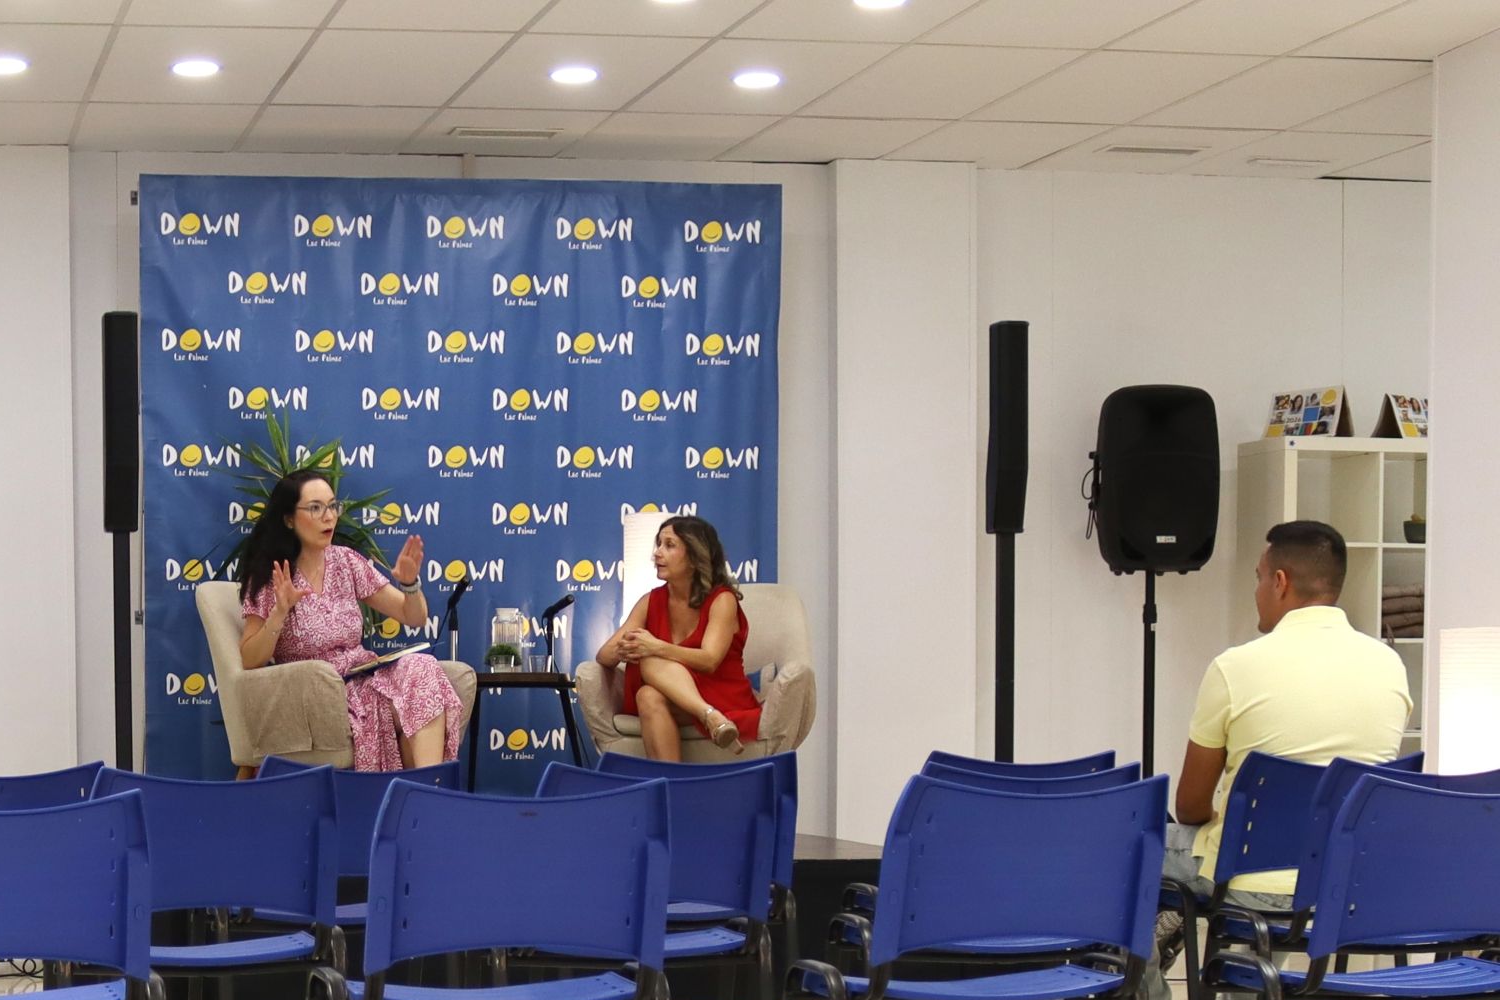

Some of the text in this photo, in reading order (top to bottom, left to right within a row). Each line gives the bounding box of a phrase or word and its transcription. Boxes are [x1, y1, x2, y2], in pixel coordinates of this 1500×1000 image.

[161, 212, 240, 238] DOWN
[294, 214, 373, 239] DOWN
[427, 215, 504, 240] DOWN
[557, 217, 633, 242] DOWN
[684, 219, 761, 244] DOWN
[173, 236, 208, 246] Las Palmas
[306, 238, 341, 248] Las Palmas
[439, 239, 473, 249] Las Palmas
[568, 241, 603, 250] Las Palmas
[696, 243, 730, 253] Las Palmas
[228, 271, 307, 296] DOWN
[361, 271, 440, 296] DOWN
[492, 273, 569, 298] DOWN
[621, 275, 697, 300] DOWN
[240, 295, 275, 305] Las Palmas
[373, 296, 408, 306] Las Palmas
[504, 297, 538, 306] Las Palmas
[633, 299, 667, 309] Las Palmas
[162, 327, 241, 353] DOWN
[295, 329, 374, 354] DOWN
[427, 330, 505, 355] DOWN
[557, 331, 634, 356] DOWN
[685, 333, 760, 358] DOWN
[174, 352, 209, 361] Las Palmas
[308, 353, 342, 363] Las Palmas
[440, 354, 474, 364] Las Palmas
[568, 355, 603, 364] Las Palmas
[697, 356, 730, 366] Las Palmas
[228, 386, 308, 411] DOWN
[361, 387, 440, 412] DOWN
[492, 387, 569, 412] DOWN
[621, 388, 698, 413] DOWN
[240, 411, 252, 420] Las
[374, 411, 409, 421] Las Palmas
[504, 412, 537, 421] Las Palmas
[633, 412, 667, 422] Las Palmas
[162, 444, 242, 468] DOWN
[428, 444, 505, 468] DOWN
[557, 444, 634, 469] DOWN
[685, 446, 759, 470] DOWN
[174, 468, 209, 477] Las Palmas
[440, 469, 474, 478] Las Palmas
[568, 469, 602, 478] Las Palmas
[697, 470, 730, 479] Las Palmas
[362, 501, 440, 526] DOWN
[492, 501, 568, 526] DOWN
[504, 526, 537, 535] Las Palmas
[427, 558, 504, 583] DOWN
[439, 583, 450, 592] Las
[567, 583, 602, 592] Las Palmas
[489, 727, 566, 751] DOWN
